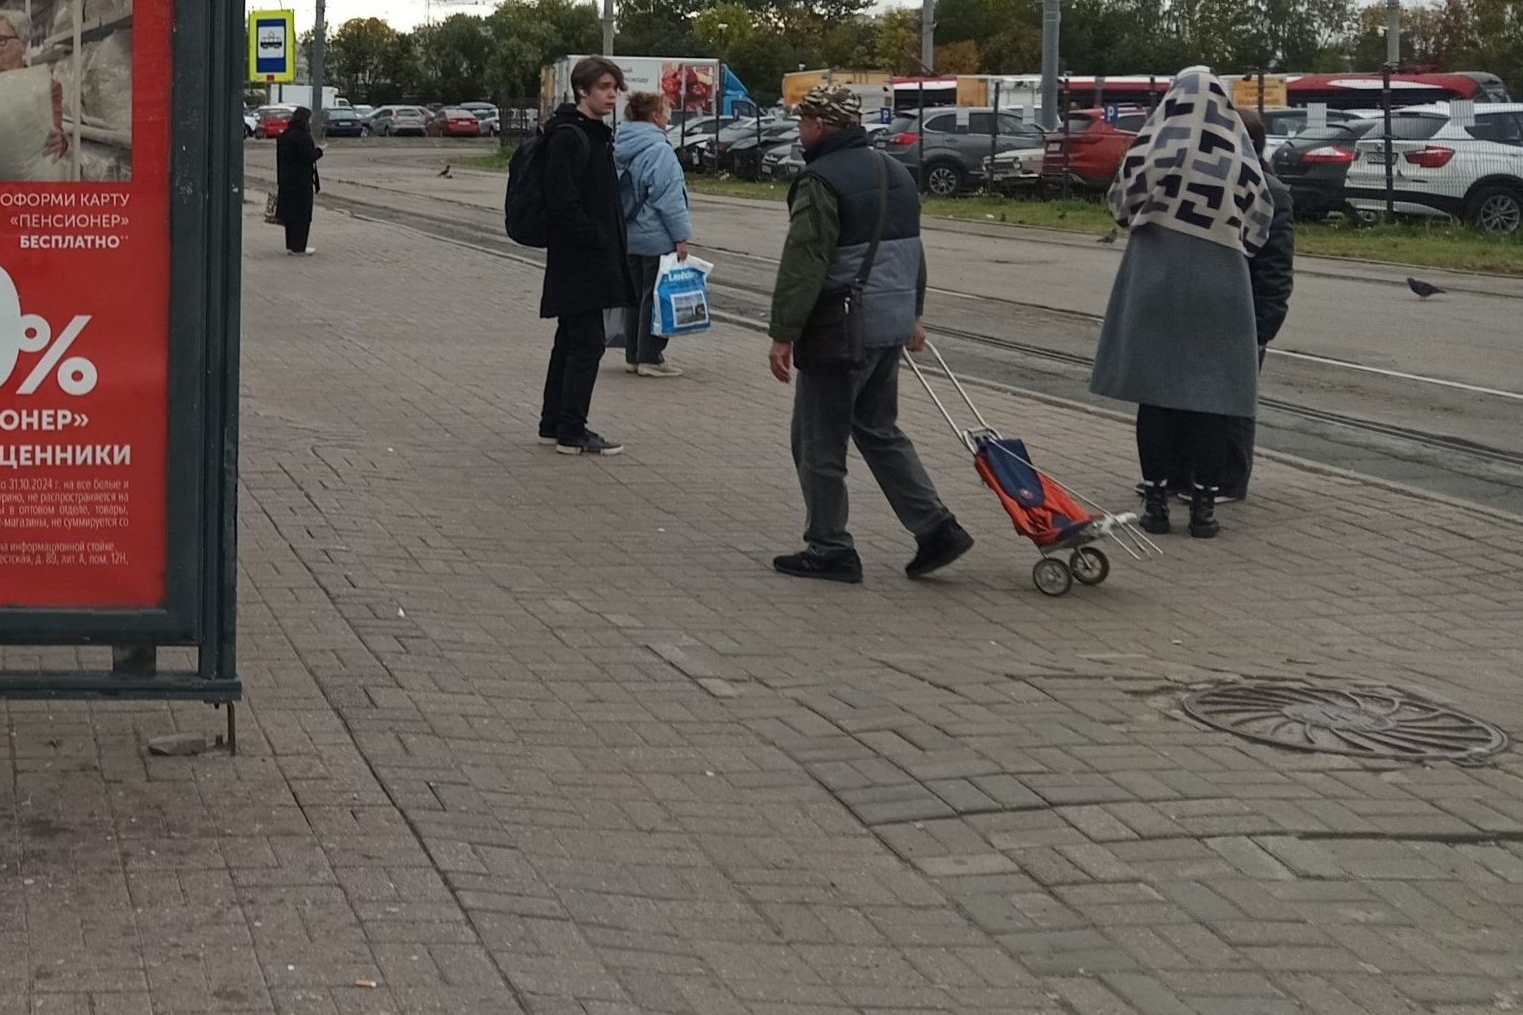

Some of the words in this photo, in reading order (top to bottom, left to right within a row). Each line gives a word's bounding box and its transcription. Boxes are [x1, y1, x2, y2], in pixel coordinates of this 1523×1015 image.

[0, 192, 76, 206] ОФОРМИ
[80, 192, 130, 206] КАРТУ
[10, 214, 129, 228] «ПЕНСИОНЕР»
[77, 481, 92, 490] все
[93, 479, 121, 490] белые
